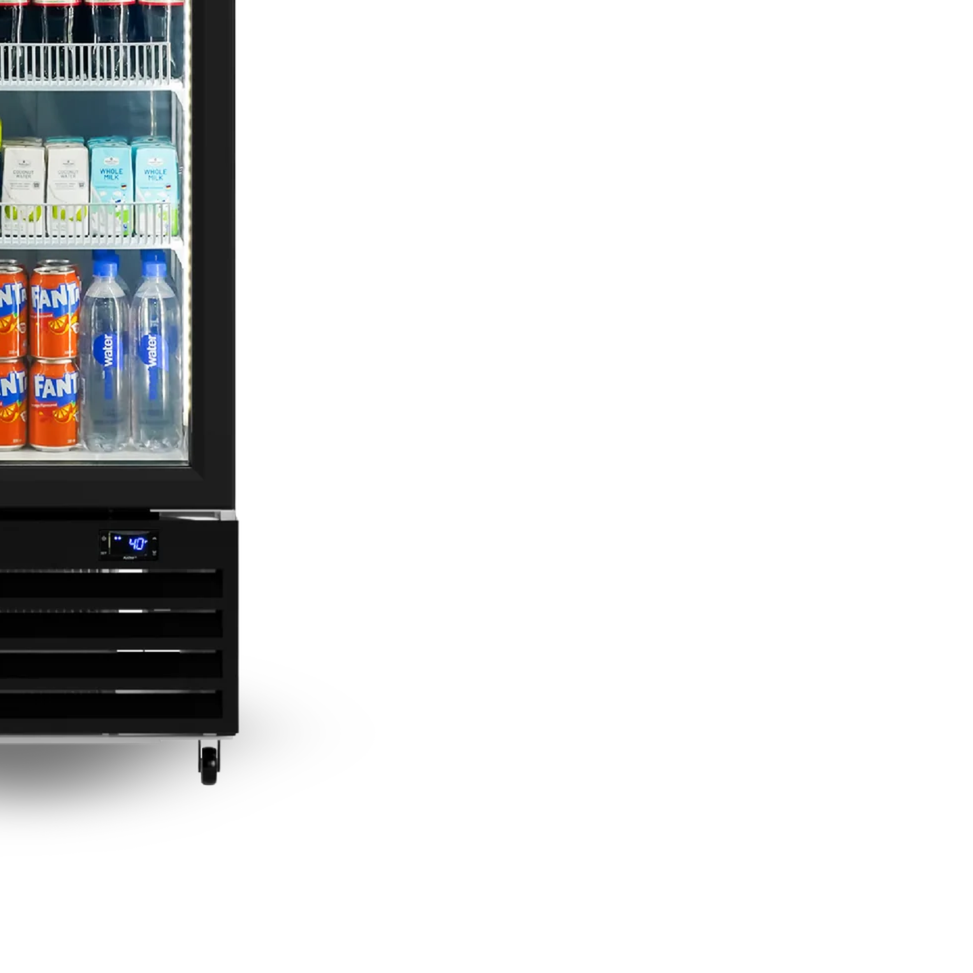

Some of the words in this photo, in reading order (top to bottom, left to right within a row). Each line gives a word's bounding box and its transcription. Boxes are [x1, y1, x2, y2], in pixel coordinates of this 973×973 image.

[103, 334, 113, 367] water
[147, 334, 157, 367] water
[34, 372, 78, 398] FANT
